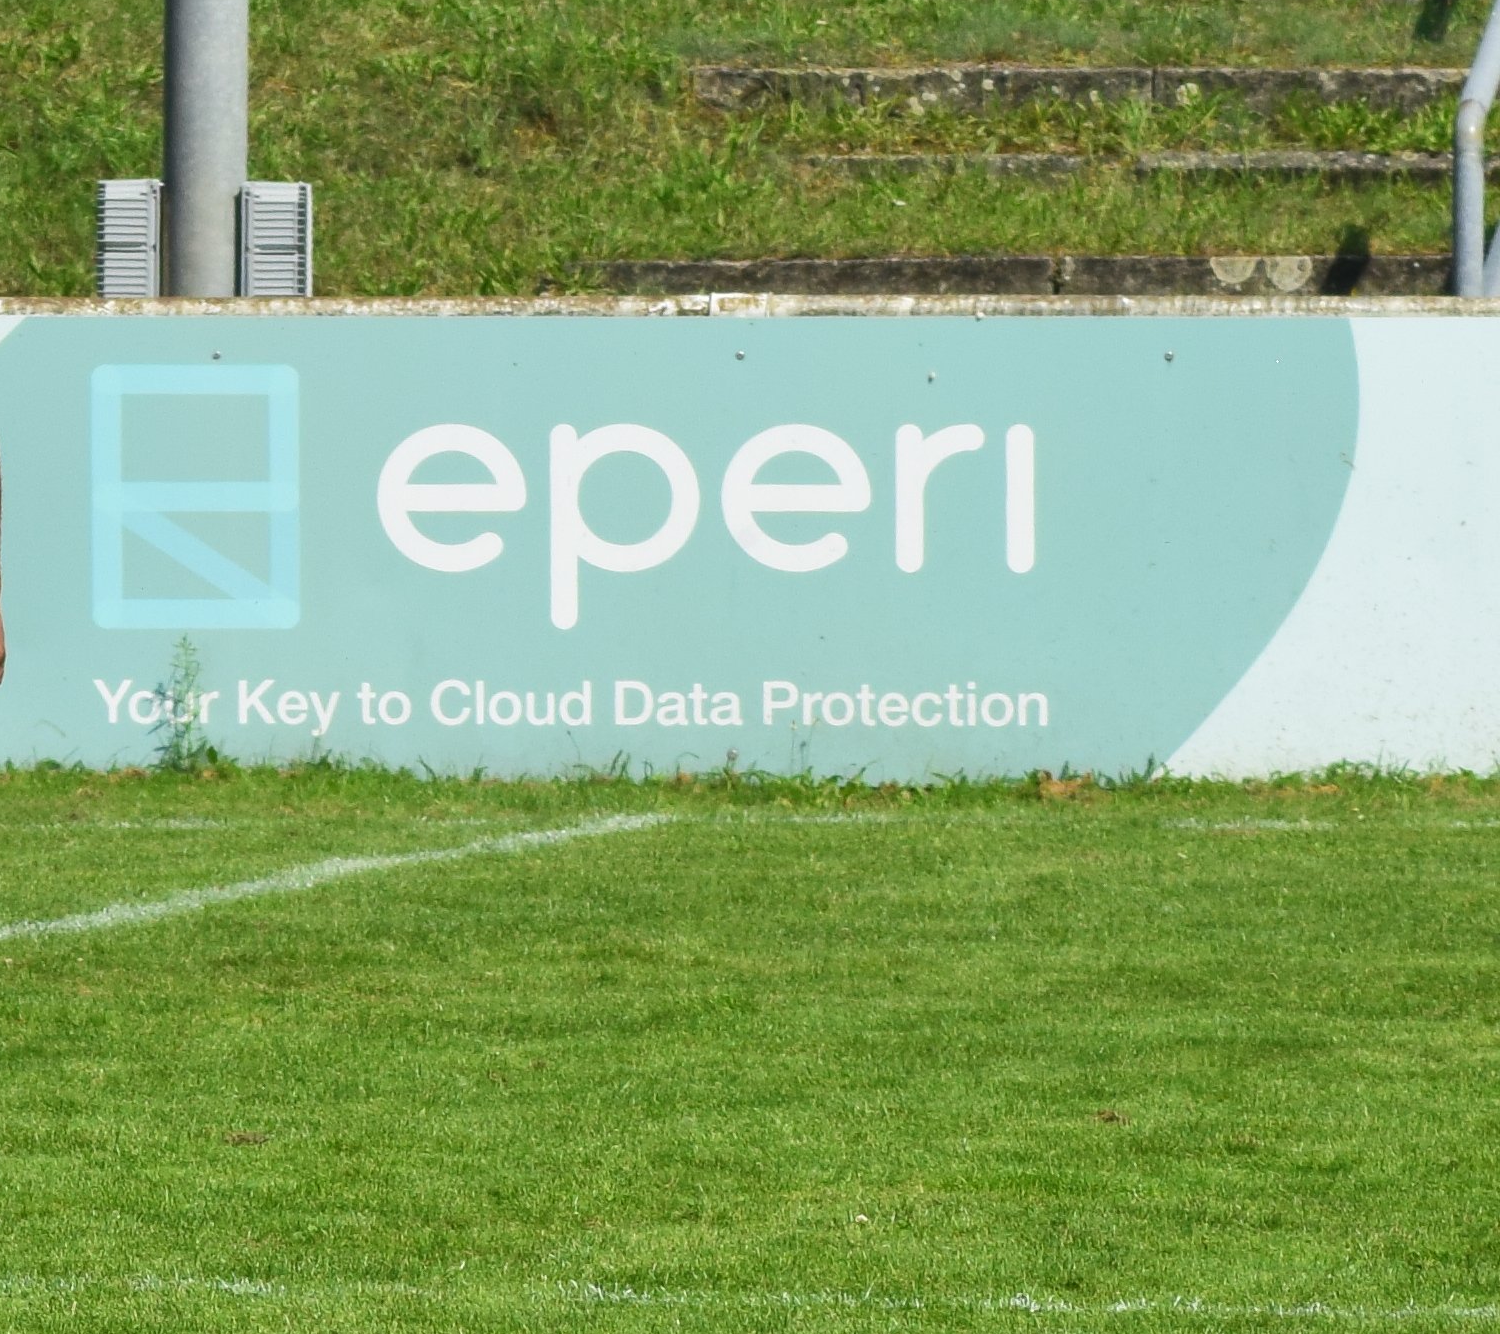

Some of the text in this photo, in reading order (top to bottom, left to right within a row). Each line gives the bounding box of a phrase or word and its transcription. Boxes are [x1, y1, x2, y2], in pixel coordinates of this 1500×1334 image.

[377, 423, 1037, 631] eperi
[237, 679, 340, 736] Key
[358, 683, 413, 726] to
[430, 680, 593, 727] Cloud
[615, 681, 743, 728] Data
[762, 681, 1050, 729] Protection
